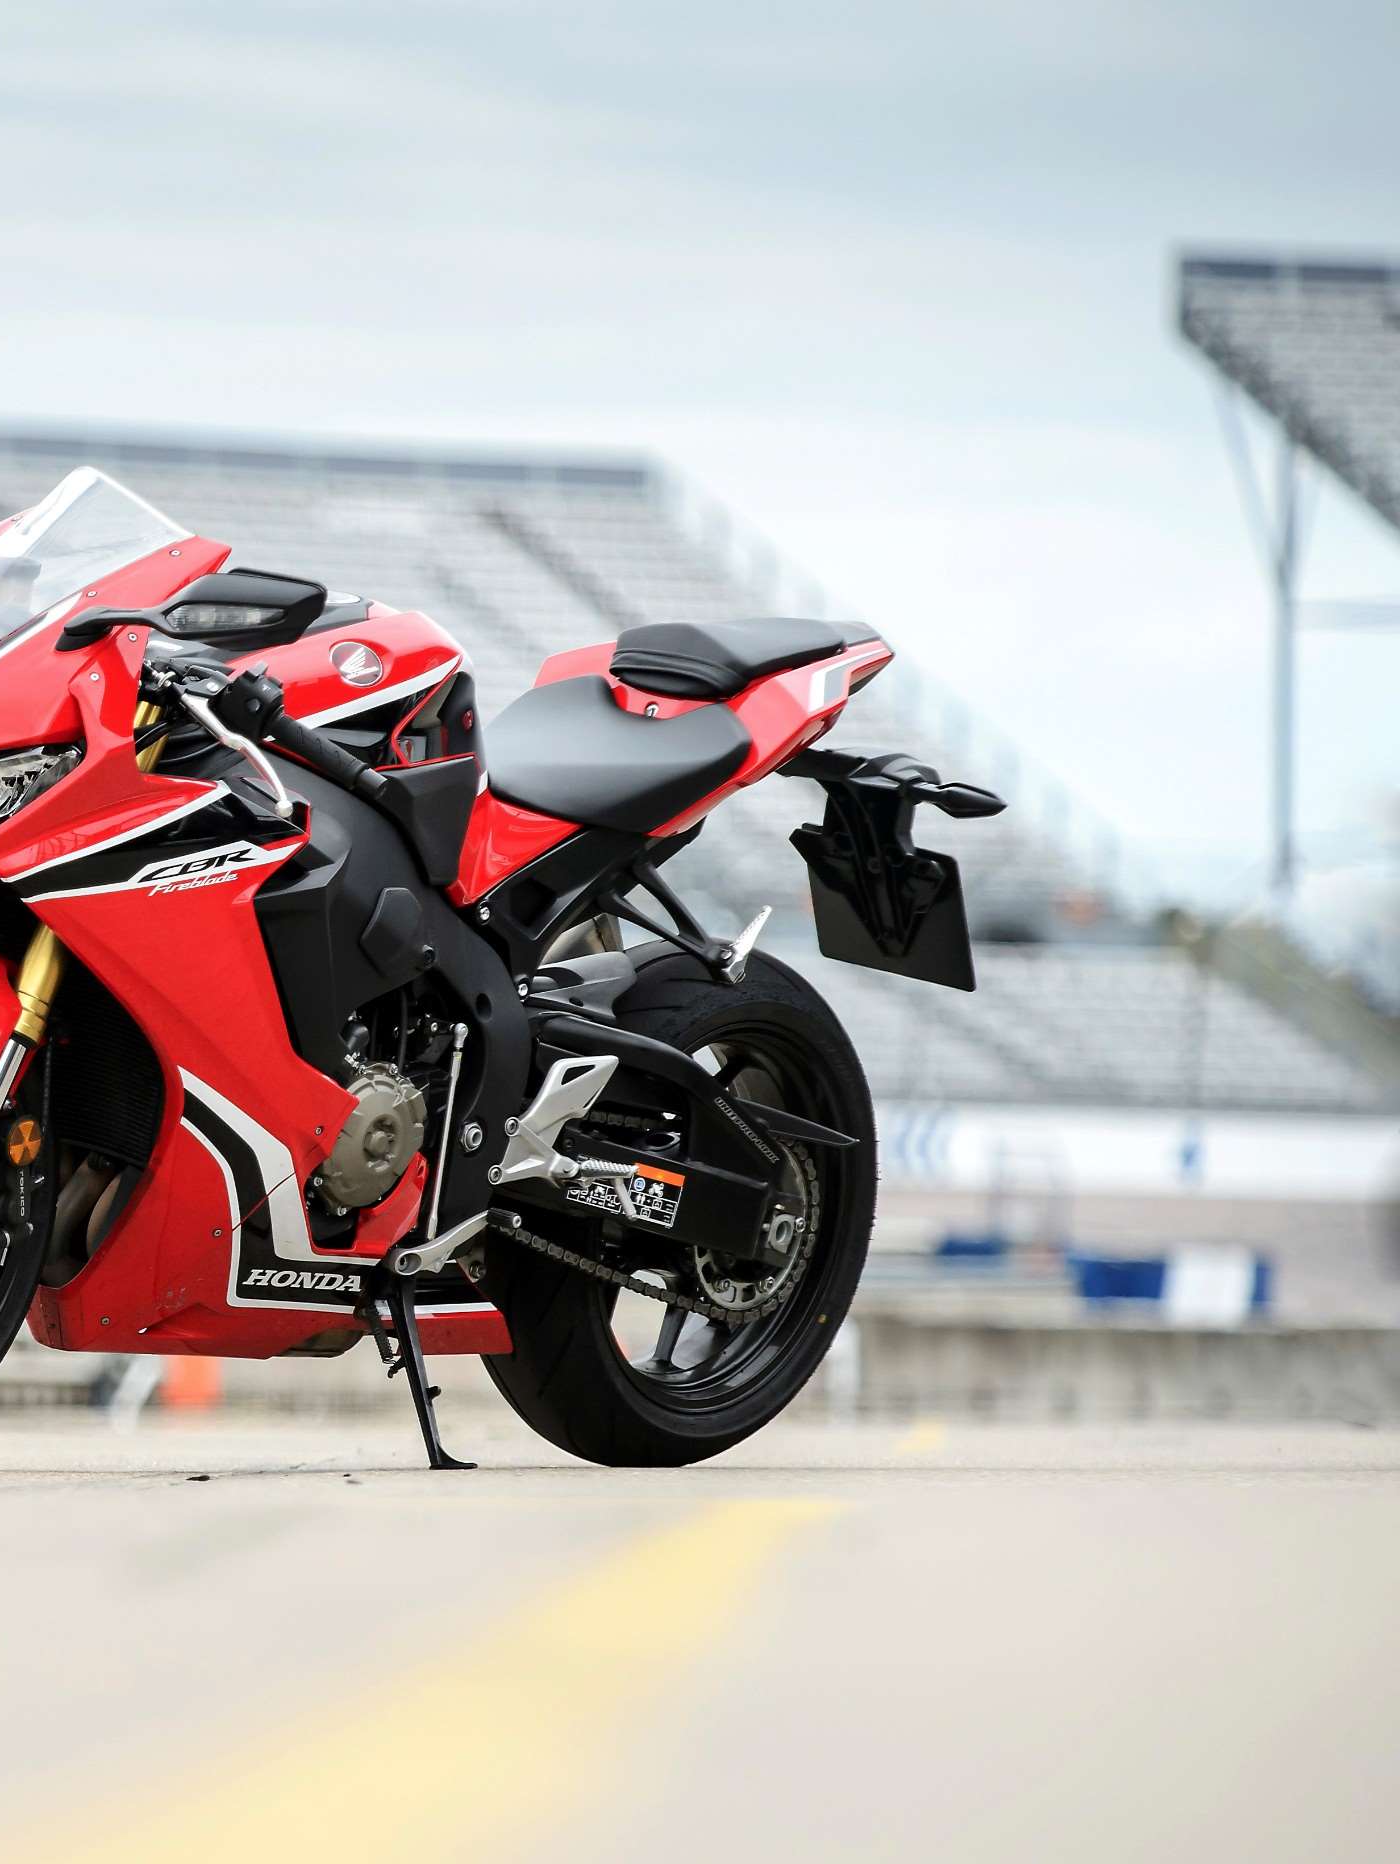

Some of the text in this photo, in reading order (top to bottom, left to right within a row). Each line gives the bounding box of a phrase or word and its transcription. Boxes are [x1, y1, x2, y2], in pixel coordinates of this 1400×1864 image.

[137, 847, 257, 883] CBR
[147, 870, 238, 897] Fireblade
[18, 1170, 26, 1217] TOKICO
[242, 1269, 363, 1293] HONDA
